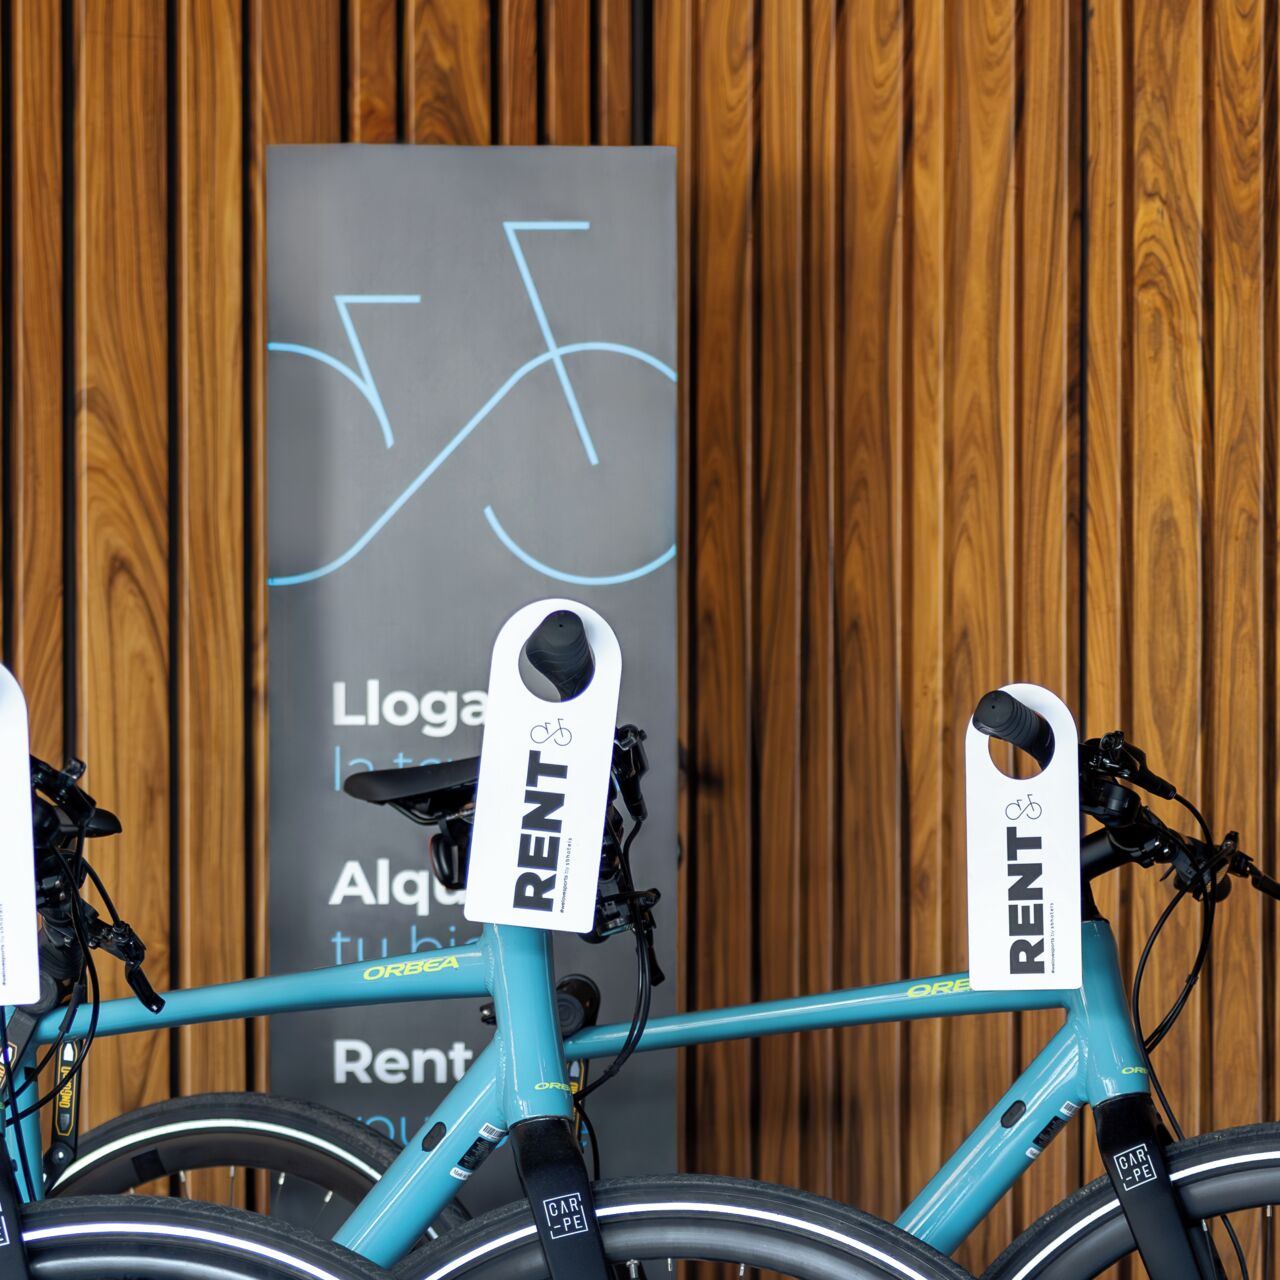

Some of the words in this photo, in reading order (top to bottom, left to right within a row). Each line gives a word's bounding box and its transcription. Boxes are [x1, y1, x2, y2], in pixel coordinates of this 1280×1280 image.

[332, 678, 489, 738] Lloga
[512, 749, 568, 912] RENT
[1006, 826, 1045, 974] RENT
[363, 956, 459, 981] ORBEA
[333, 1038, 473, 1084] Rent
[1119, 1149, 1146, 1169] CAR
[549, 1198, 579, 1216] CAR
